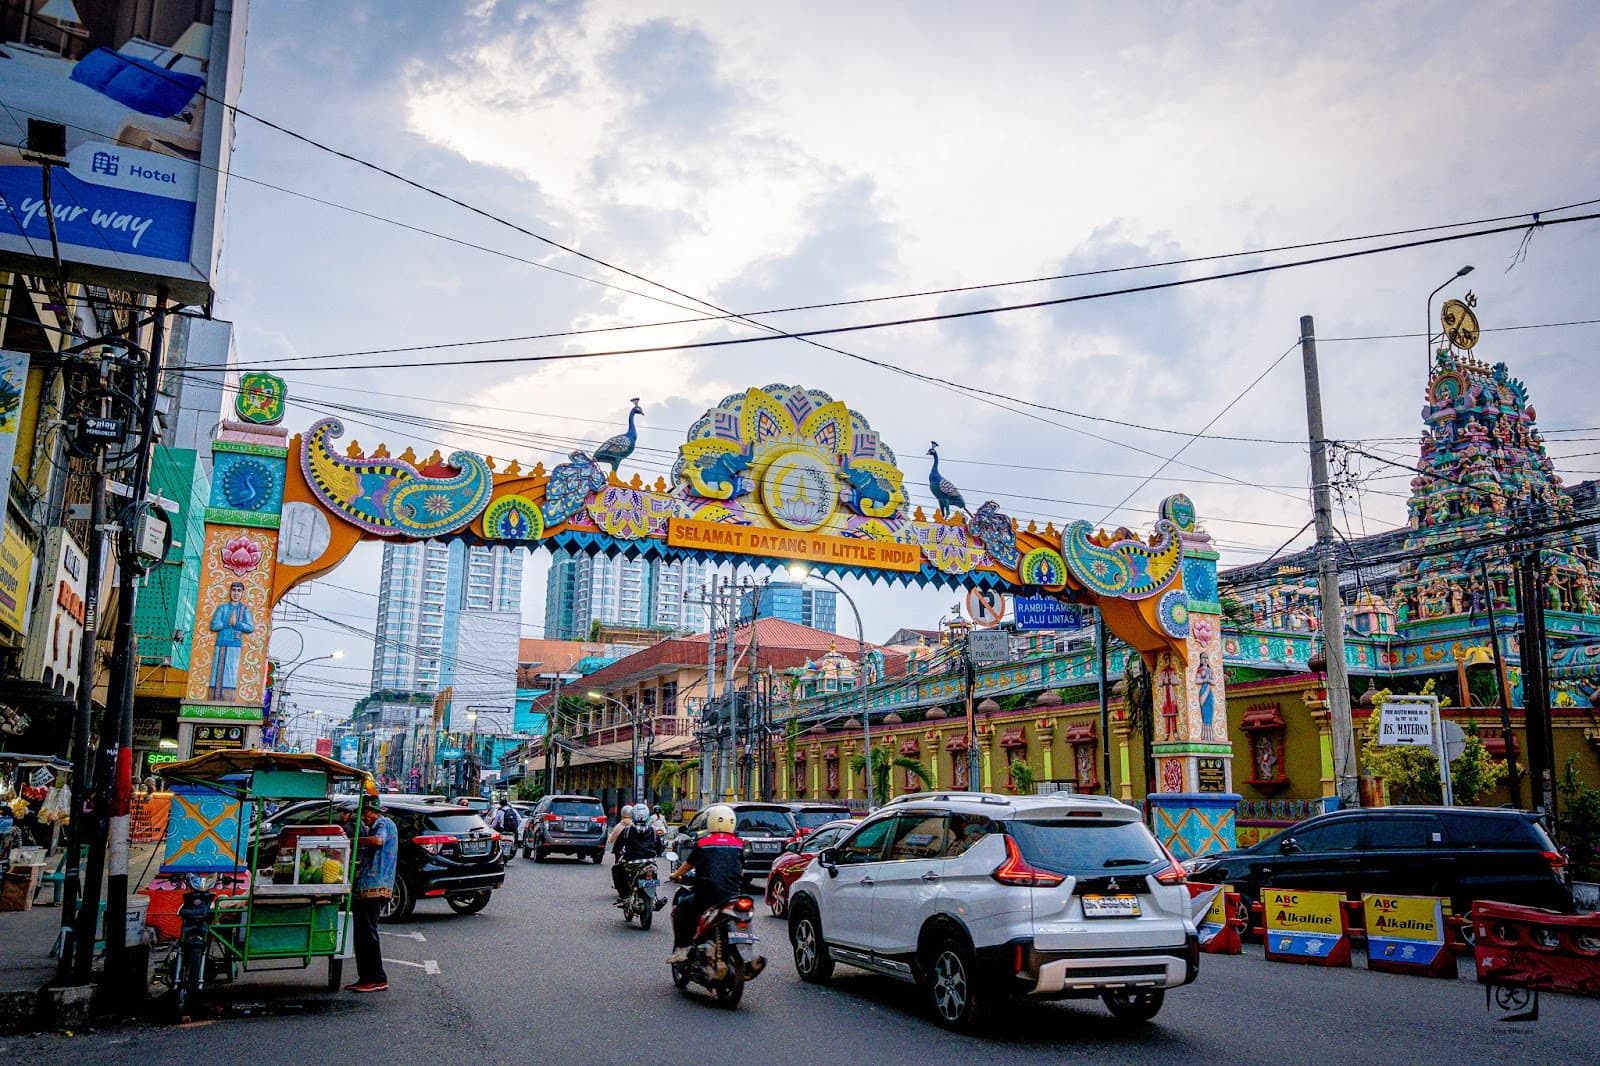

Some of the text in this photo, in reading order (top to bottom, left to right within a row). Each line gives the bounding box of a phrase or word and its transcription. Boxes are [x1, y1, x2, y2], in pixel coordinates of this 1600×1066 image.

[130, 164, 177, 185] Hotel
[20, 197, 89, 229] your
[91, 208, 153, 249] way
[675, 525, 914, 565] SELAMAT DATANG DI LITTLE INDIA
[1023, 614, 1075, 625] LALU LINTAS
[1383, 723, 1429, 736] RS. MATERNA
[1275, 894, 1299, 905] ABC
[1374, 898, 1399, 909] ABC
[1275, 910, 1333, 926] Alkaline
[1375, 915, 1434, 931] Alkaline
